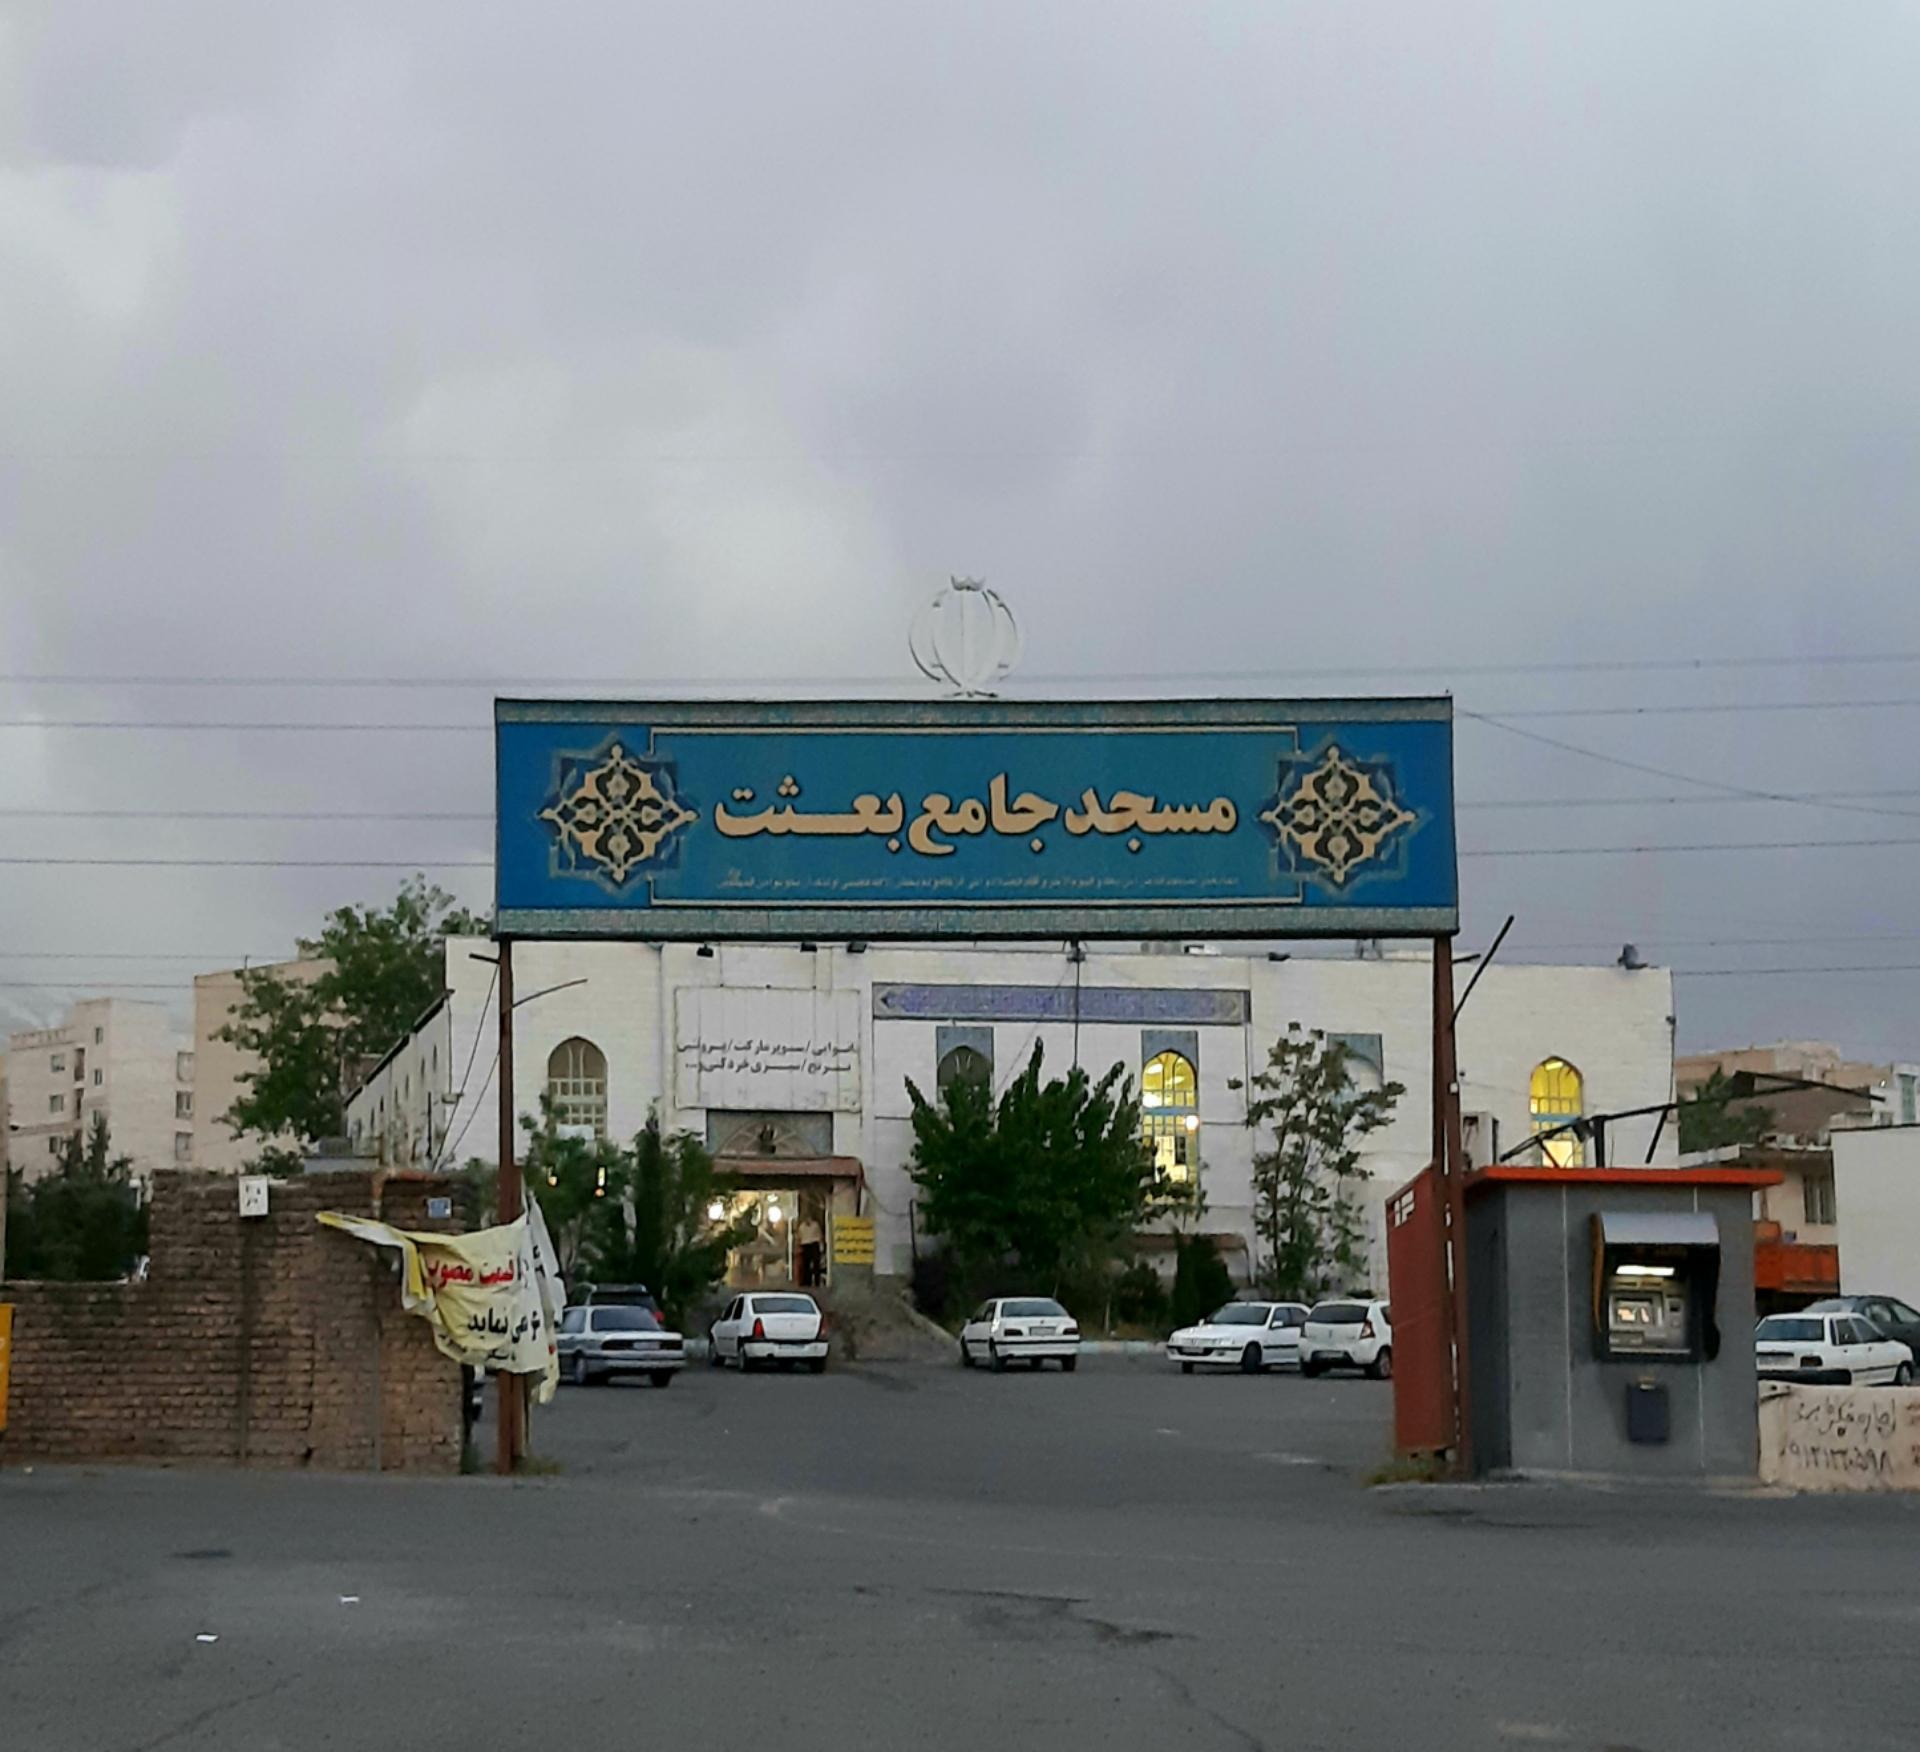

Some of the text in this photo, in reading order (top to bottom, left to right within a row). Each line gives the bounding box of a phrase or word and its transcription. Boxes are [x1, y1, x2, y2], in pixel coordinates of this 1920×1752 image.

[714, 773, 1238, 856] مسجد جامع بعثت
